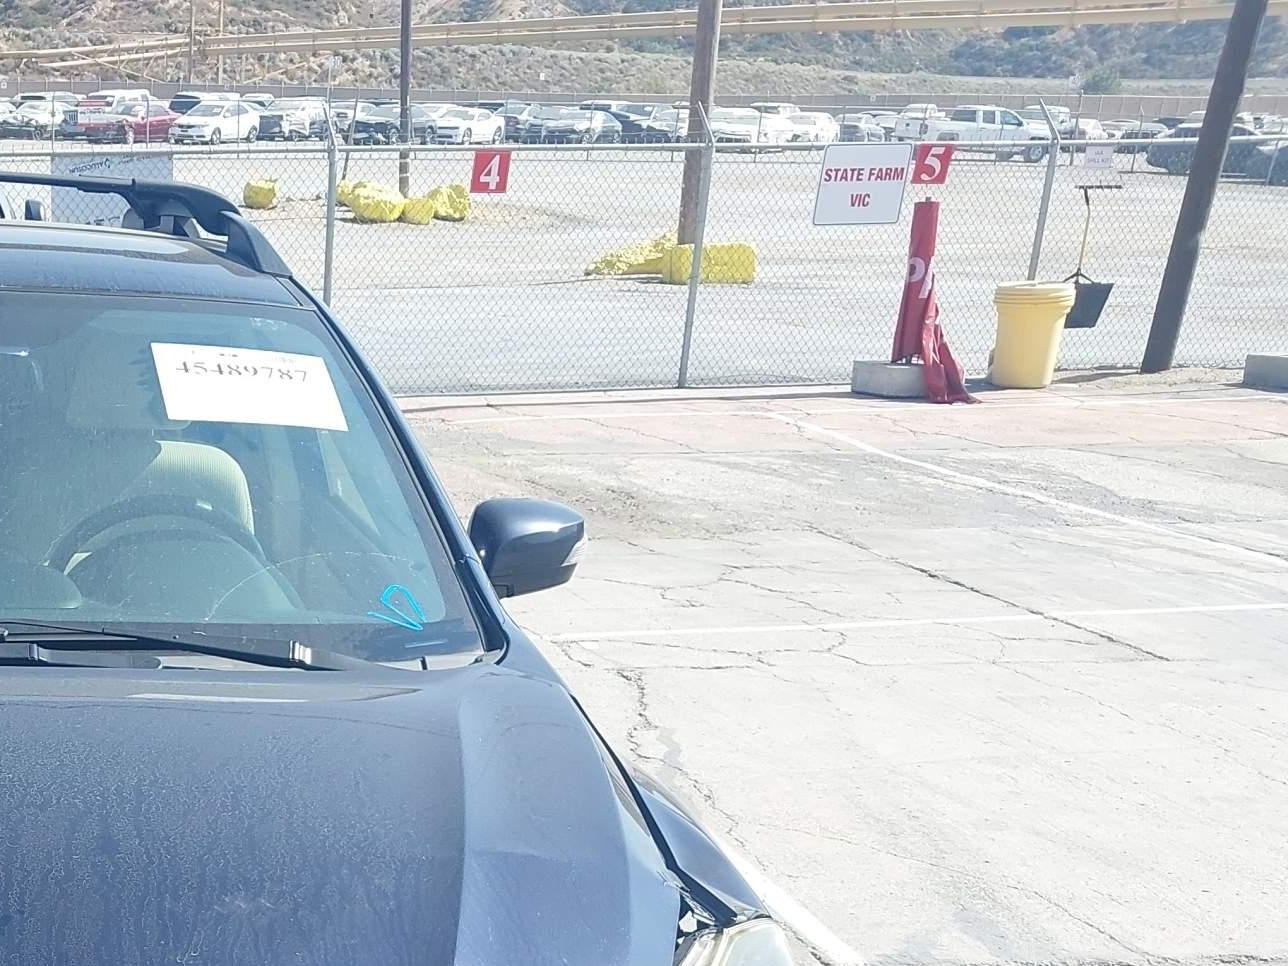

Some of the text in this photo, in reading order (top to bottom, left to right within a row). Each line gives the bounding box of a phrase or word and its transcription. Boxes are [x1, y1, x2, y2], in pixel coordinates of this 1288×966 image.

[479, 154, 500, 190] 4
[920, 147, 946, 180] 5
[824, 167, 905, 182] STATE FARM
[850, 193, 871, 207] VIC
[176, 361, 307, 382] 45489787
